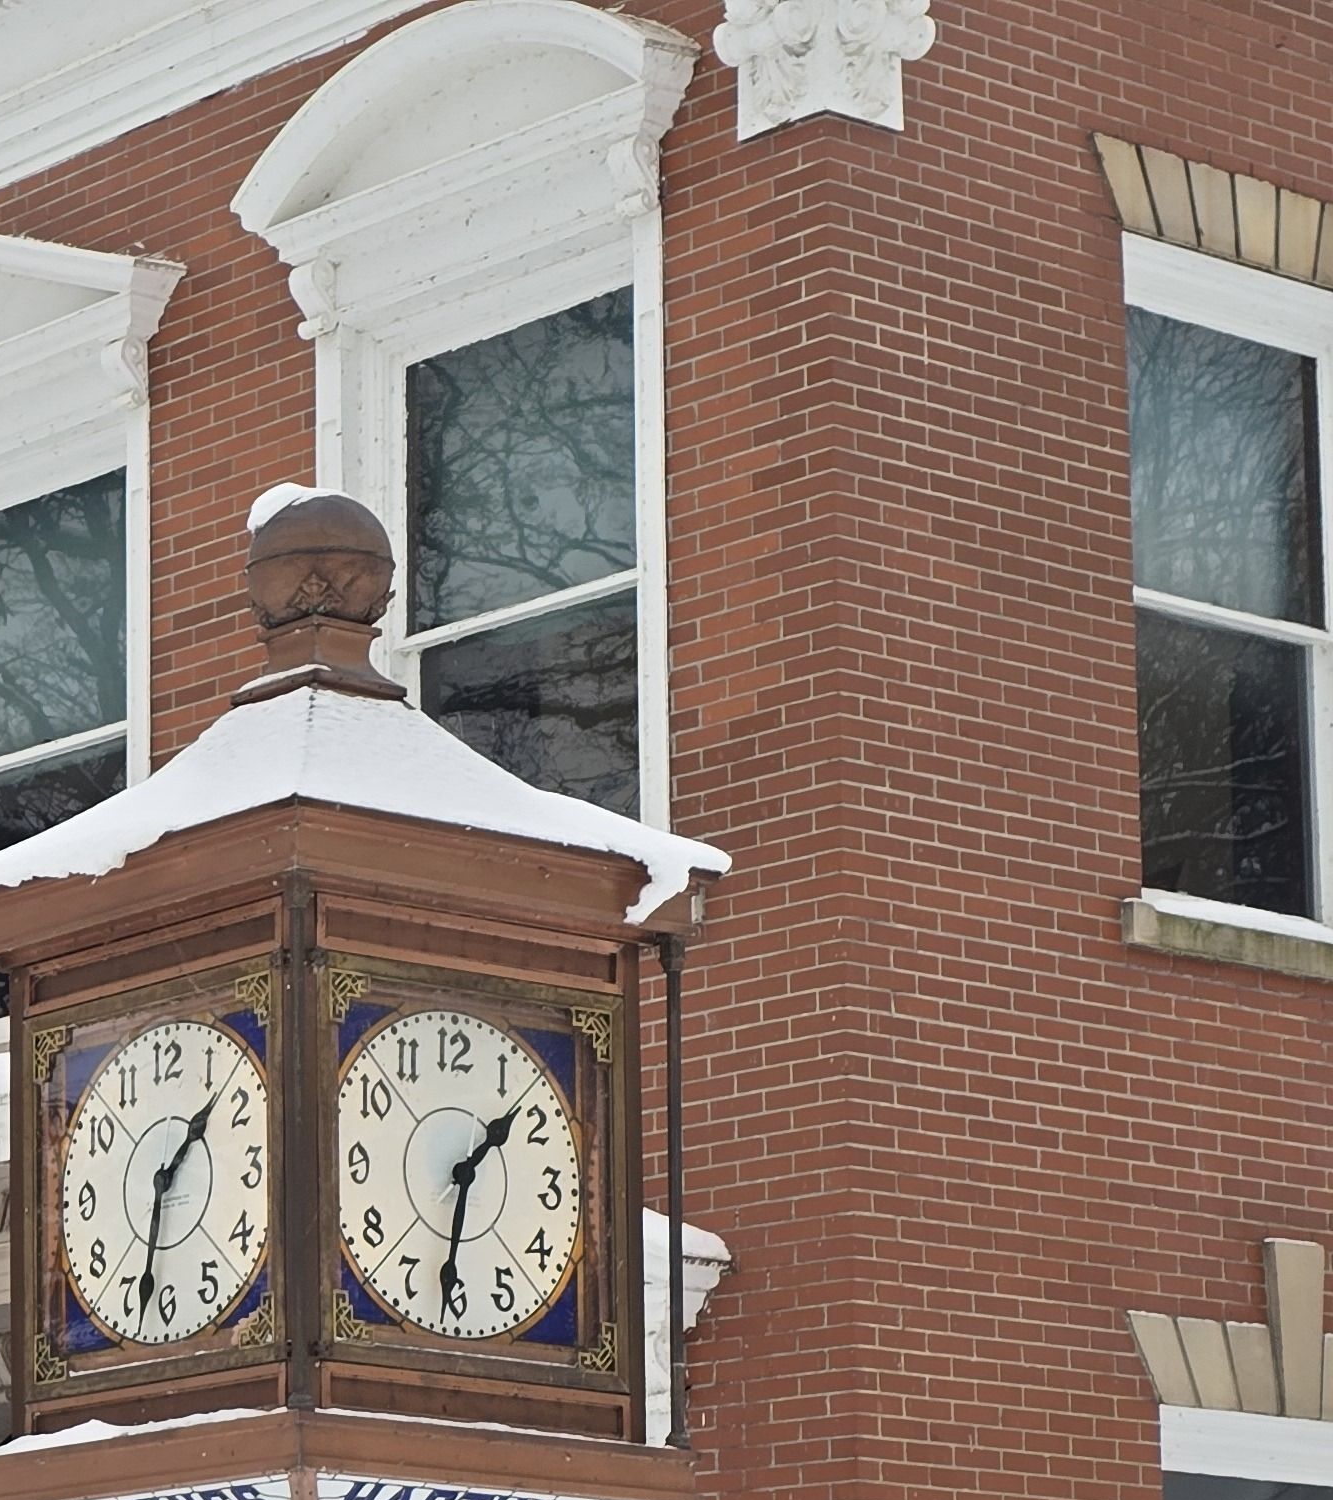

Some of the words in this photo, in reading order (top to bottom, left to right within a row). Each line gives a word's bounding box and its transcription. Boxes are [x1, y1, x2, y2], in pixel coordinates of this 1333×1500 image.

[153, 1040, 183, 1086] 12
[205, 1046, 214, 1092] 1
[396, 1037, 419, 1084] 11
[437, 1026, 473, 1074] 12
[118, 1064, 137, 1110] 11
[360, 1073, 392, 1121] 10
[497, 1053, 508, 1098] 1
[230, 1086, 251, 1129] 2
[527, 1104, 549, 1145] 2
[89, 1113, 115, 1158] 10
[241, 1145, 262, 1189] 3
[348, 1141, 370, 1184] 9
[79, 1180, 96, 1221] 9
[537, 1166, 562, 1210] 3
[228, 1209, 255, 1256] 4
[362, 1205, 384, 1248] 8
[89, 1237, 106, 1279] 8
[524, 1226, 553, 1273] 4
[119, 1276, 137, 1317] 7
[197, 1260, 218, 1304] 5
[398, 1255, 420, 1300] 7
[448, 1278, 467, 1320] 6
[491, 1266, 515, 1312] 5
[158, 1284, 176, 1326] 6
